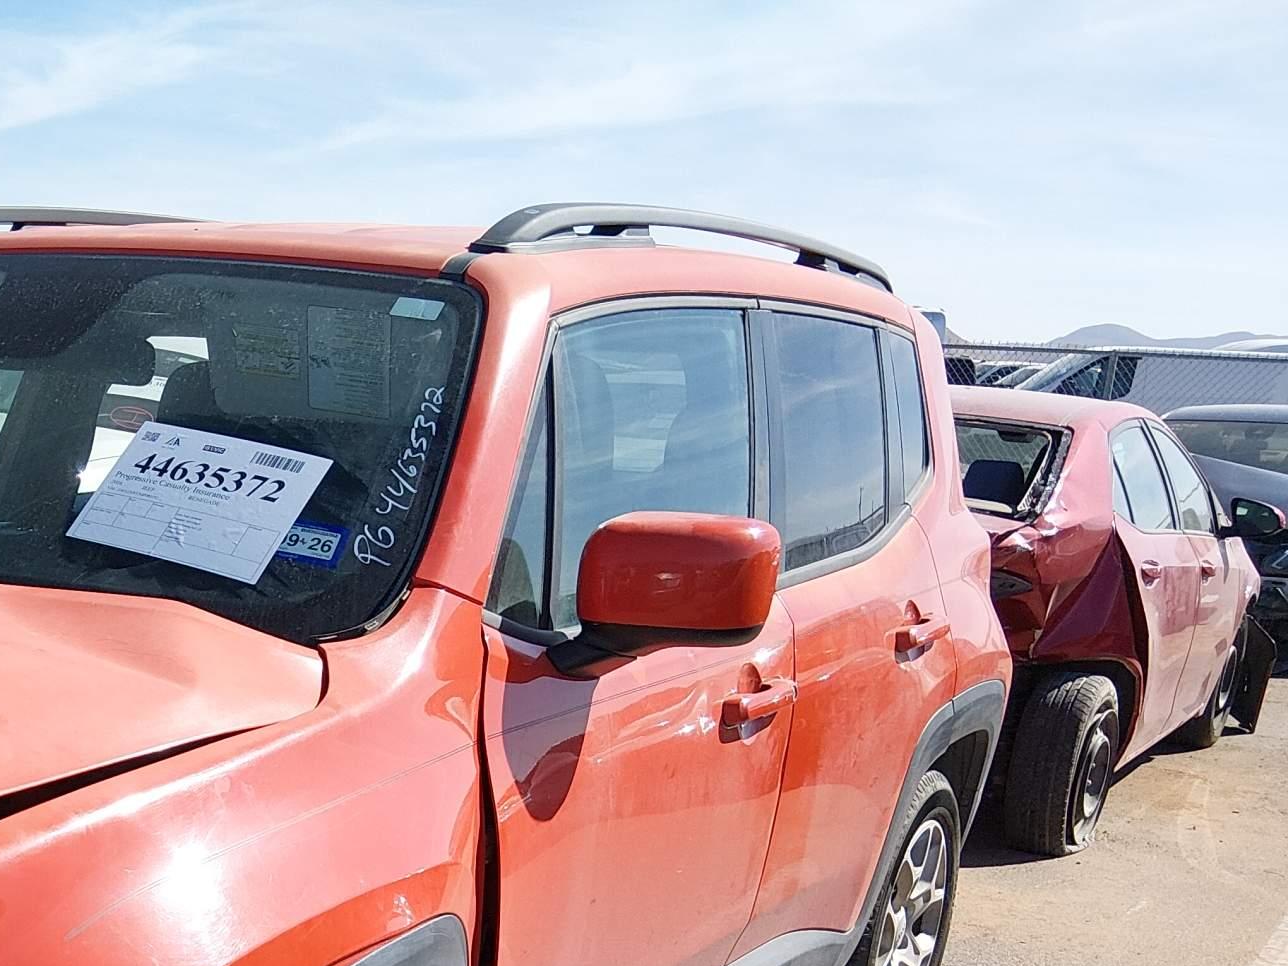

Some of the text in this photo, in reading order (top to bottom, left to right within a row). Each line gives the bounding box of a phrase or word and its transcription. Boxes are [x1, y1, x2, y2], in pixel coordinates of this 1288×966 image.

[375, 387, 446, 515] 44635372
[115, 471, 158, 486] Progressive
[159, 480, 190, 493] Casualty
[192, 486, 231, 501] Insurance
[134, 453, 286, 503] 44635372
